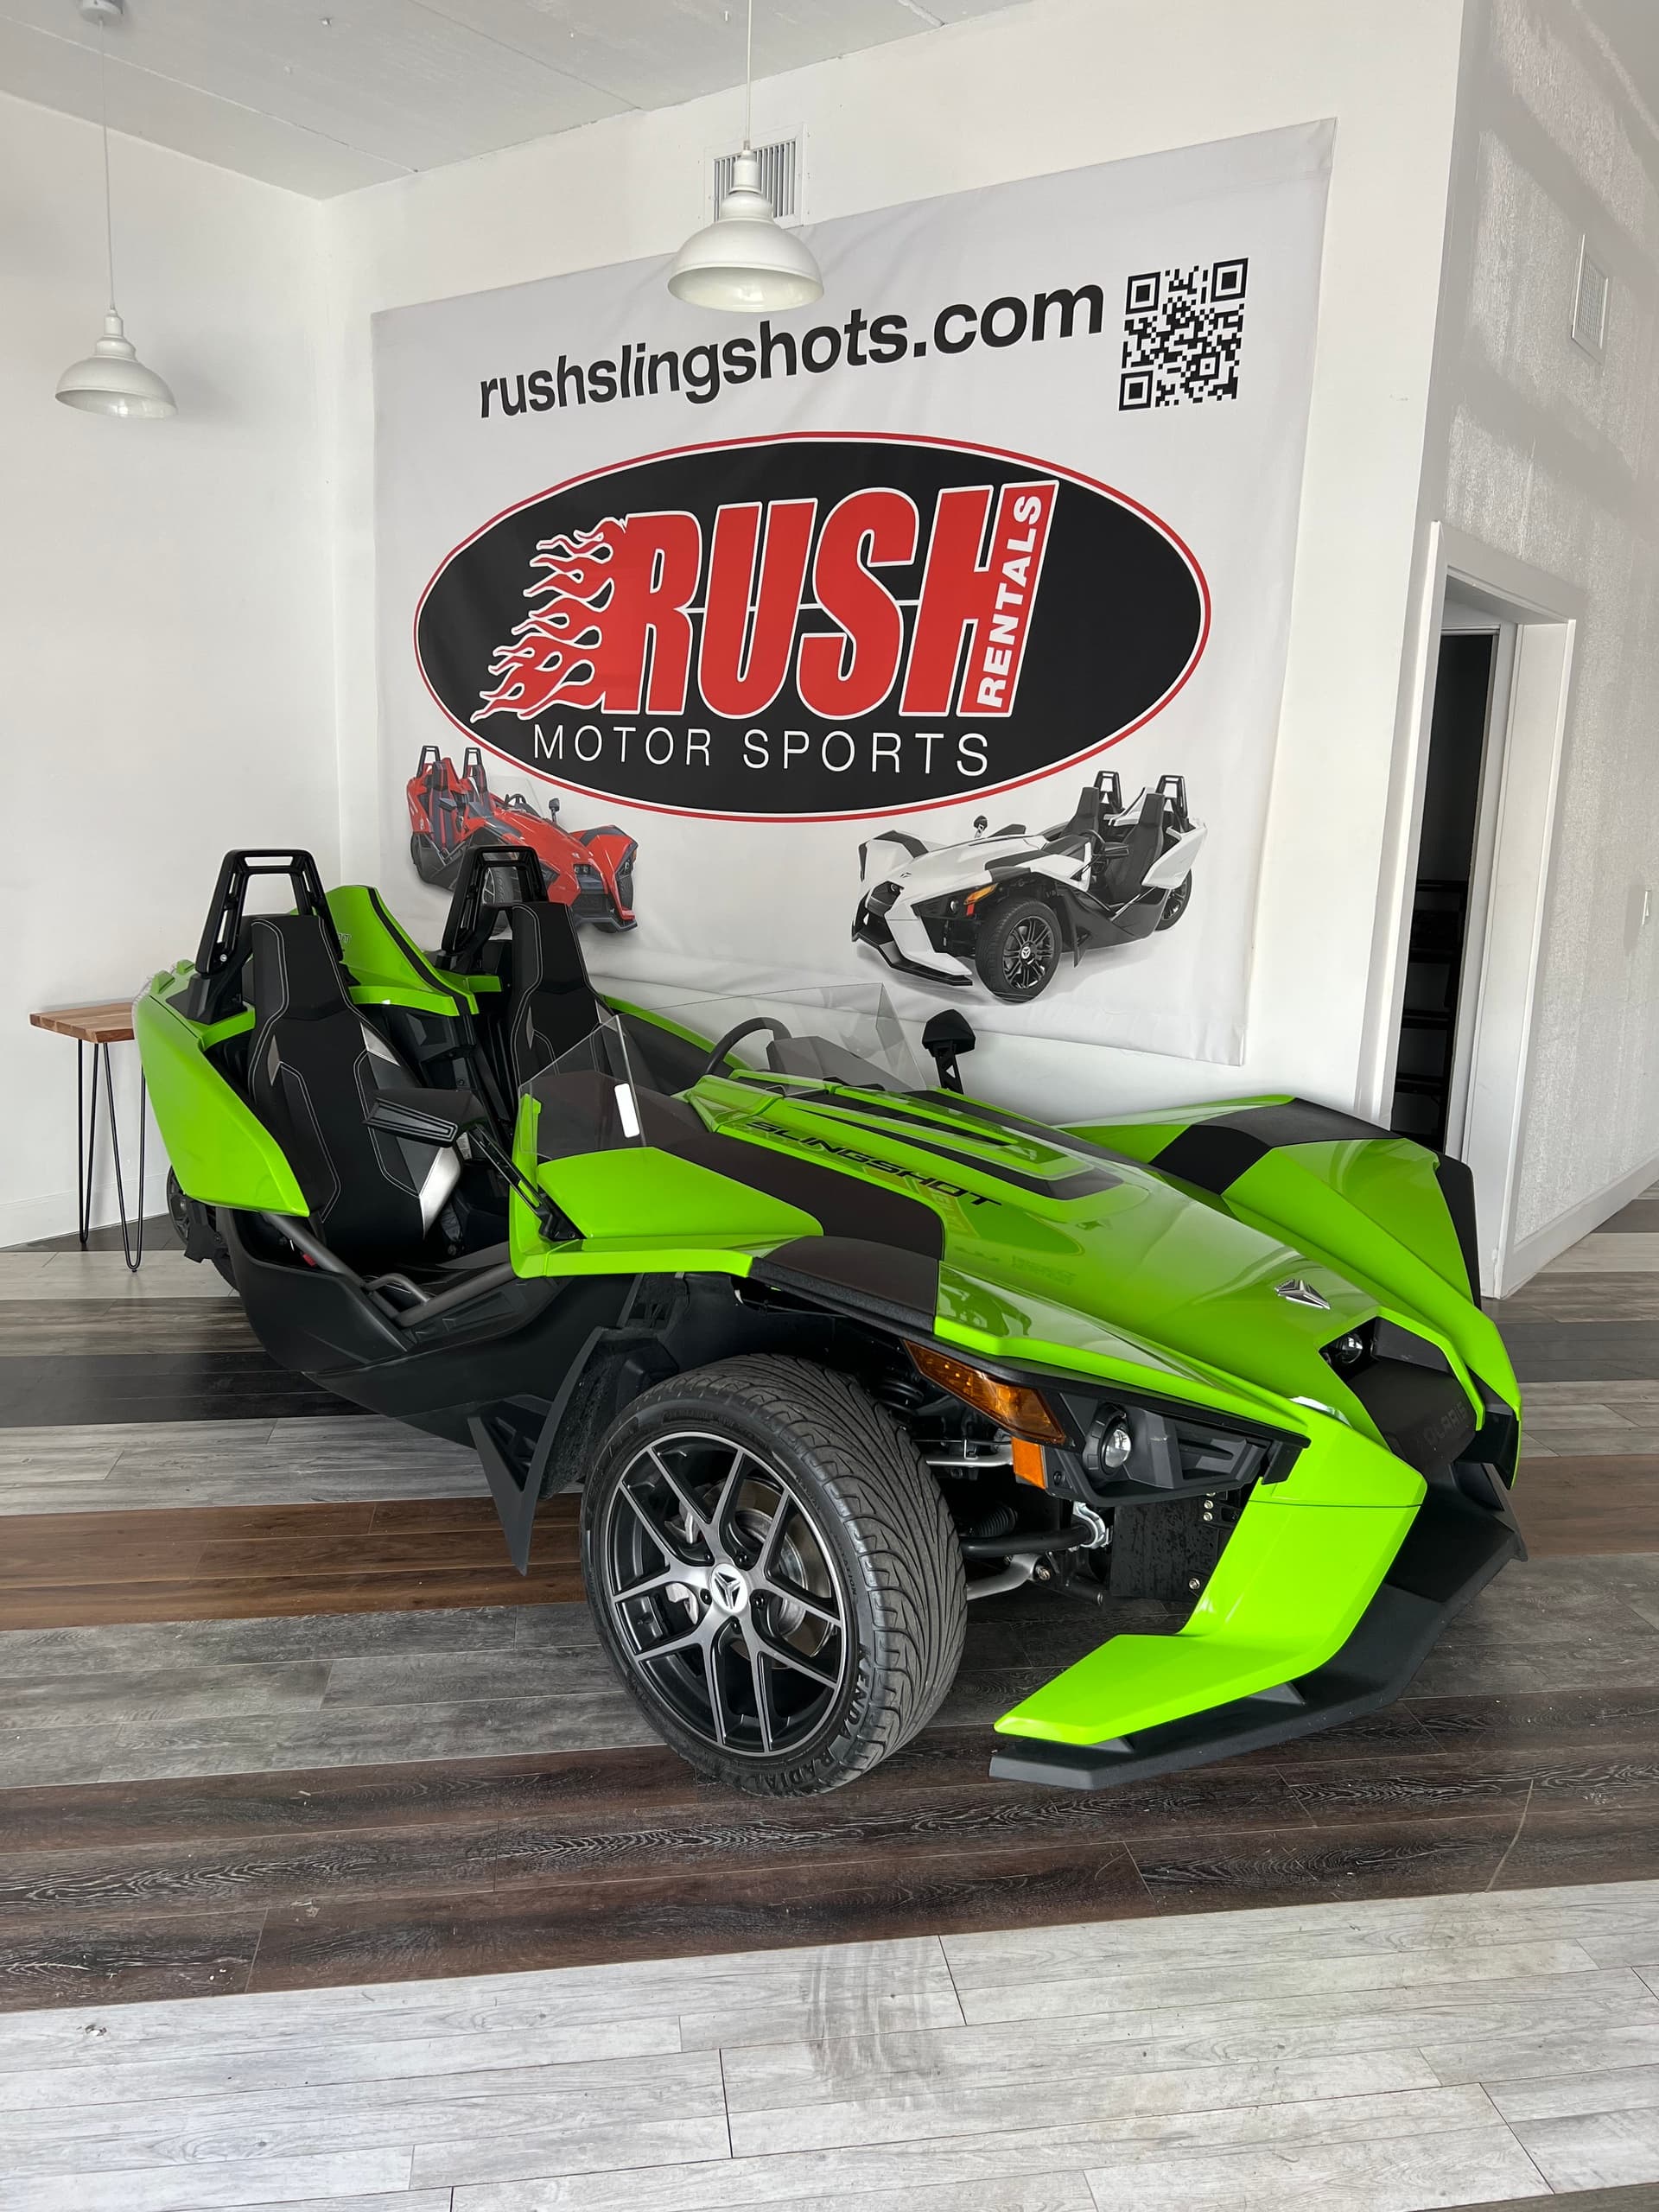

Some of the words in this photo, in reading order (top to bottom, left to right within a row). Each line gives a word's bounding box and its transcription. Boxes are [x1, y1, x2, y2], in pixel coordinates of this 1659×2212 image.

[480, 284, 1104, 418] rushslingshots.com
[598, 482, 997, 719] RUSH
[976, 495, 1043, 709] RENTALS
[533, 723, 712, 767] MOTOR
[742, 728, 988, 778] SPORTS
[746, 1122, 1003, 1207] SLINGSHOT
